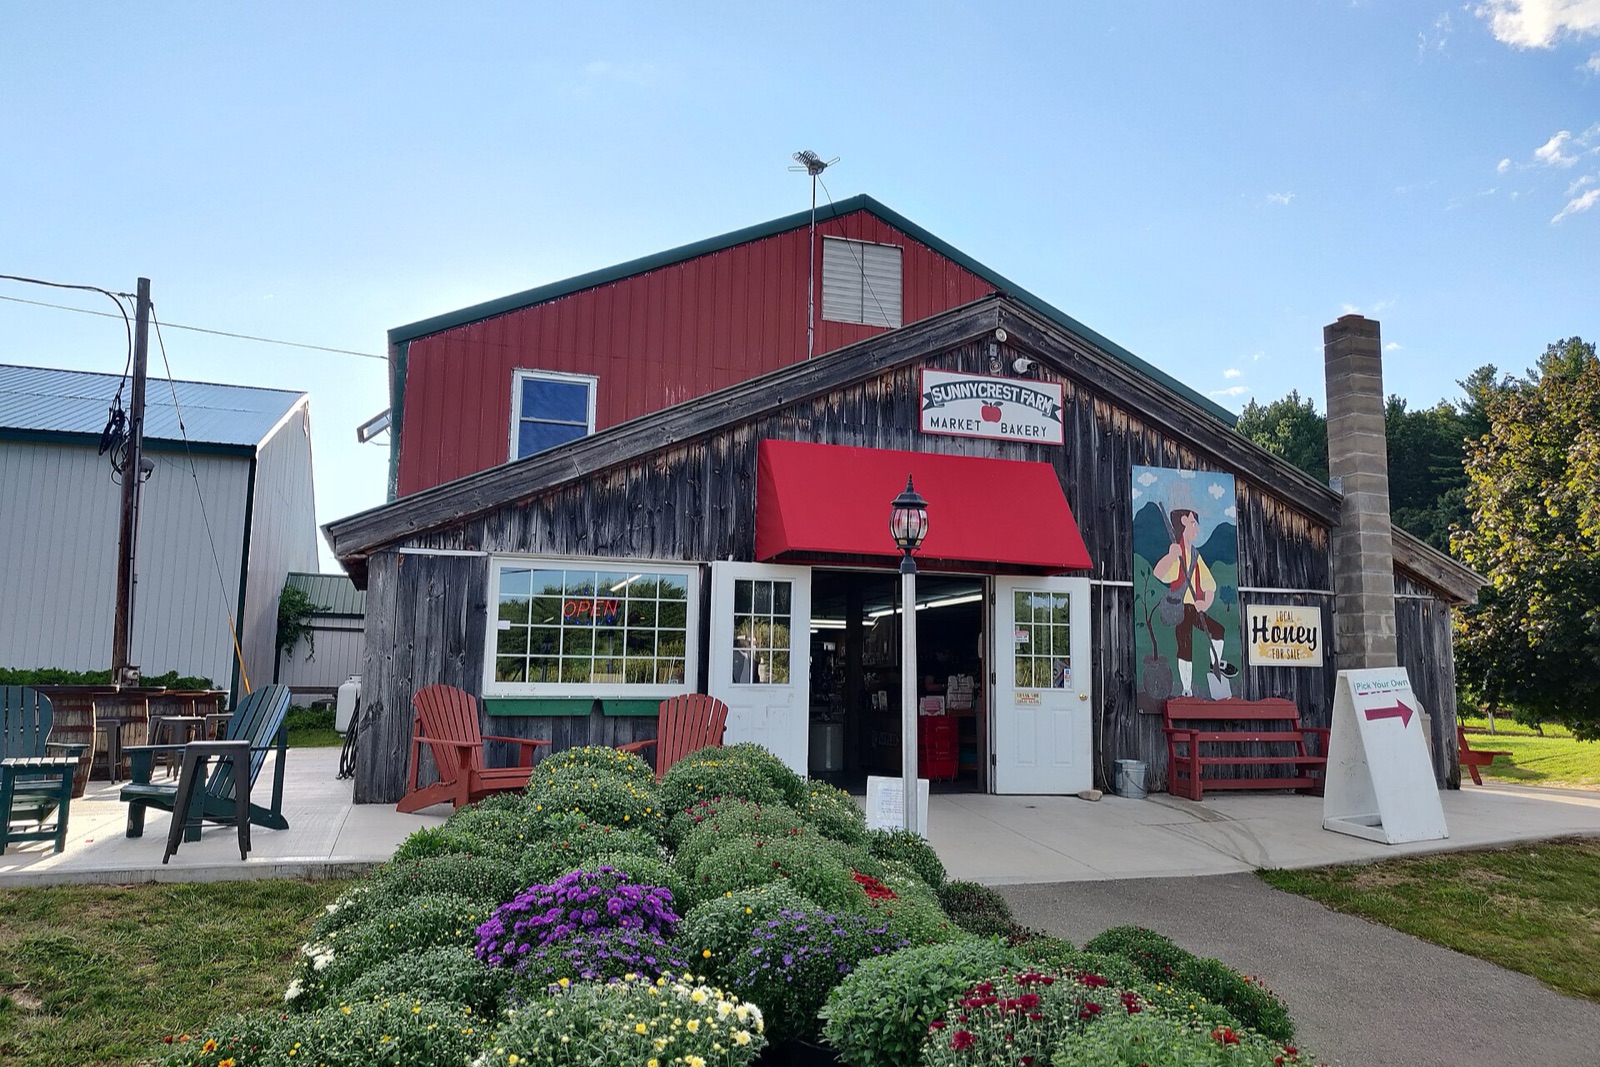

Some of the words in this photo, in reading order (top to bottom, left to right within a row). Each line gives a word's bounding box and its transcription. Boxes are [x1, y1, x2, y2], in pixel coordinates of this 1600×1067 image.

[931, 382, 1019, 401] SUNNYCREST
[1020, 388, 1054, 414] FARM
[930, 416, 982, 432] MARKET
[1000, 422, 1047, 437] BAKERY
[563, 599, 619, 617] OPEN
[1275, 610, 1295, 622] LOCAL
[1252, 615, 1317, 651] Honey
[1272, 648, 1285, 660] FOR
[1287, 649, 1301, 660] SALE
[1356, 682, 1371, 690] Pick
[1372, 681, 1389, 689] Your
[1391, 679, 1409, 687] Own
